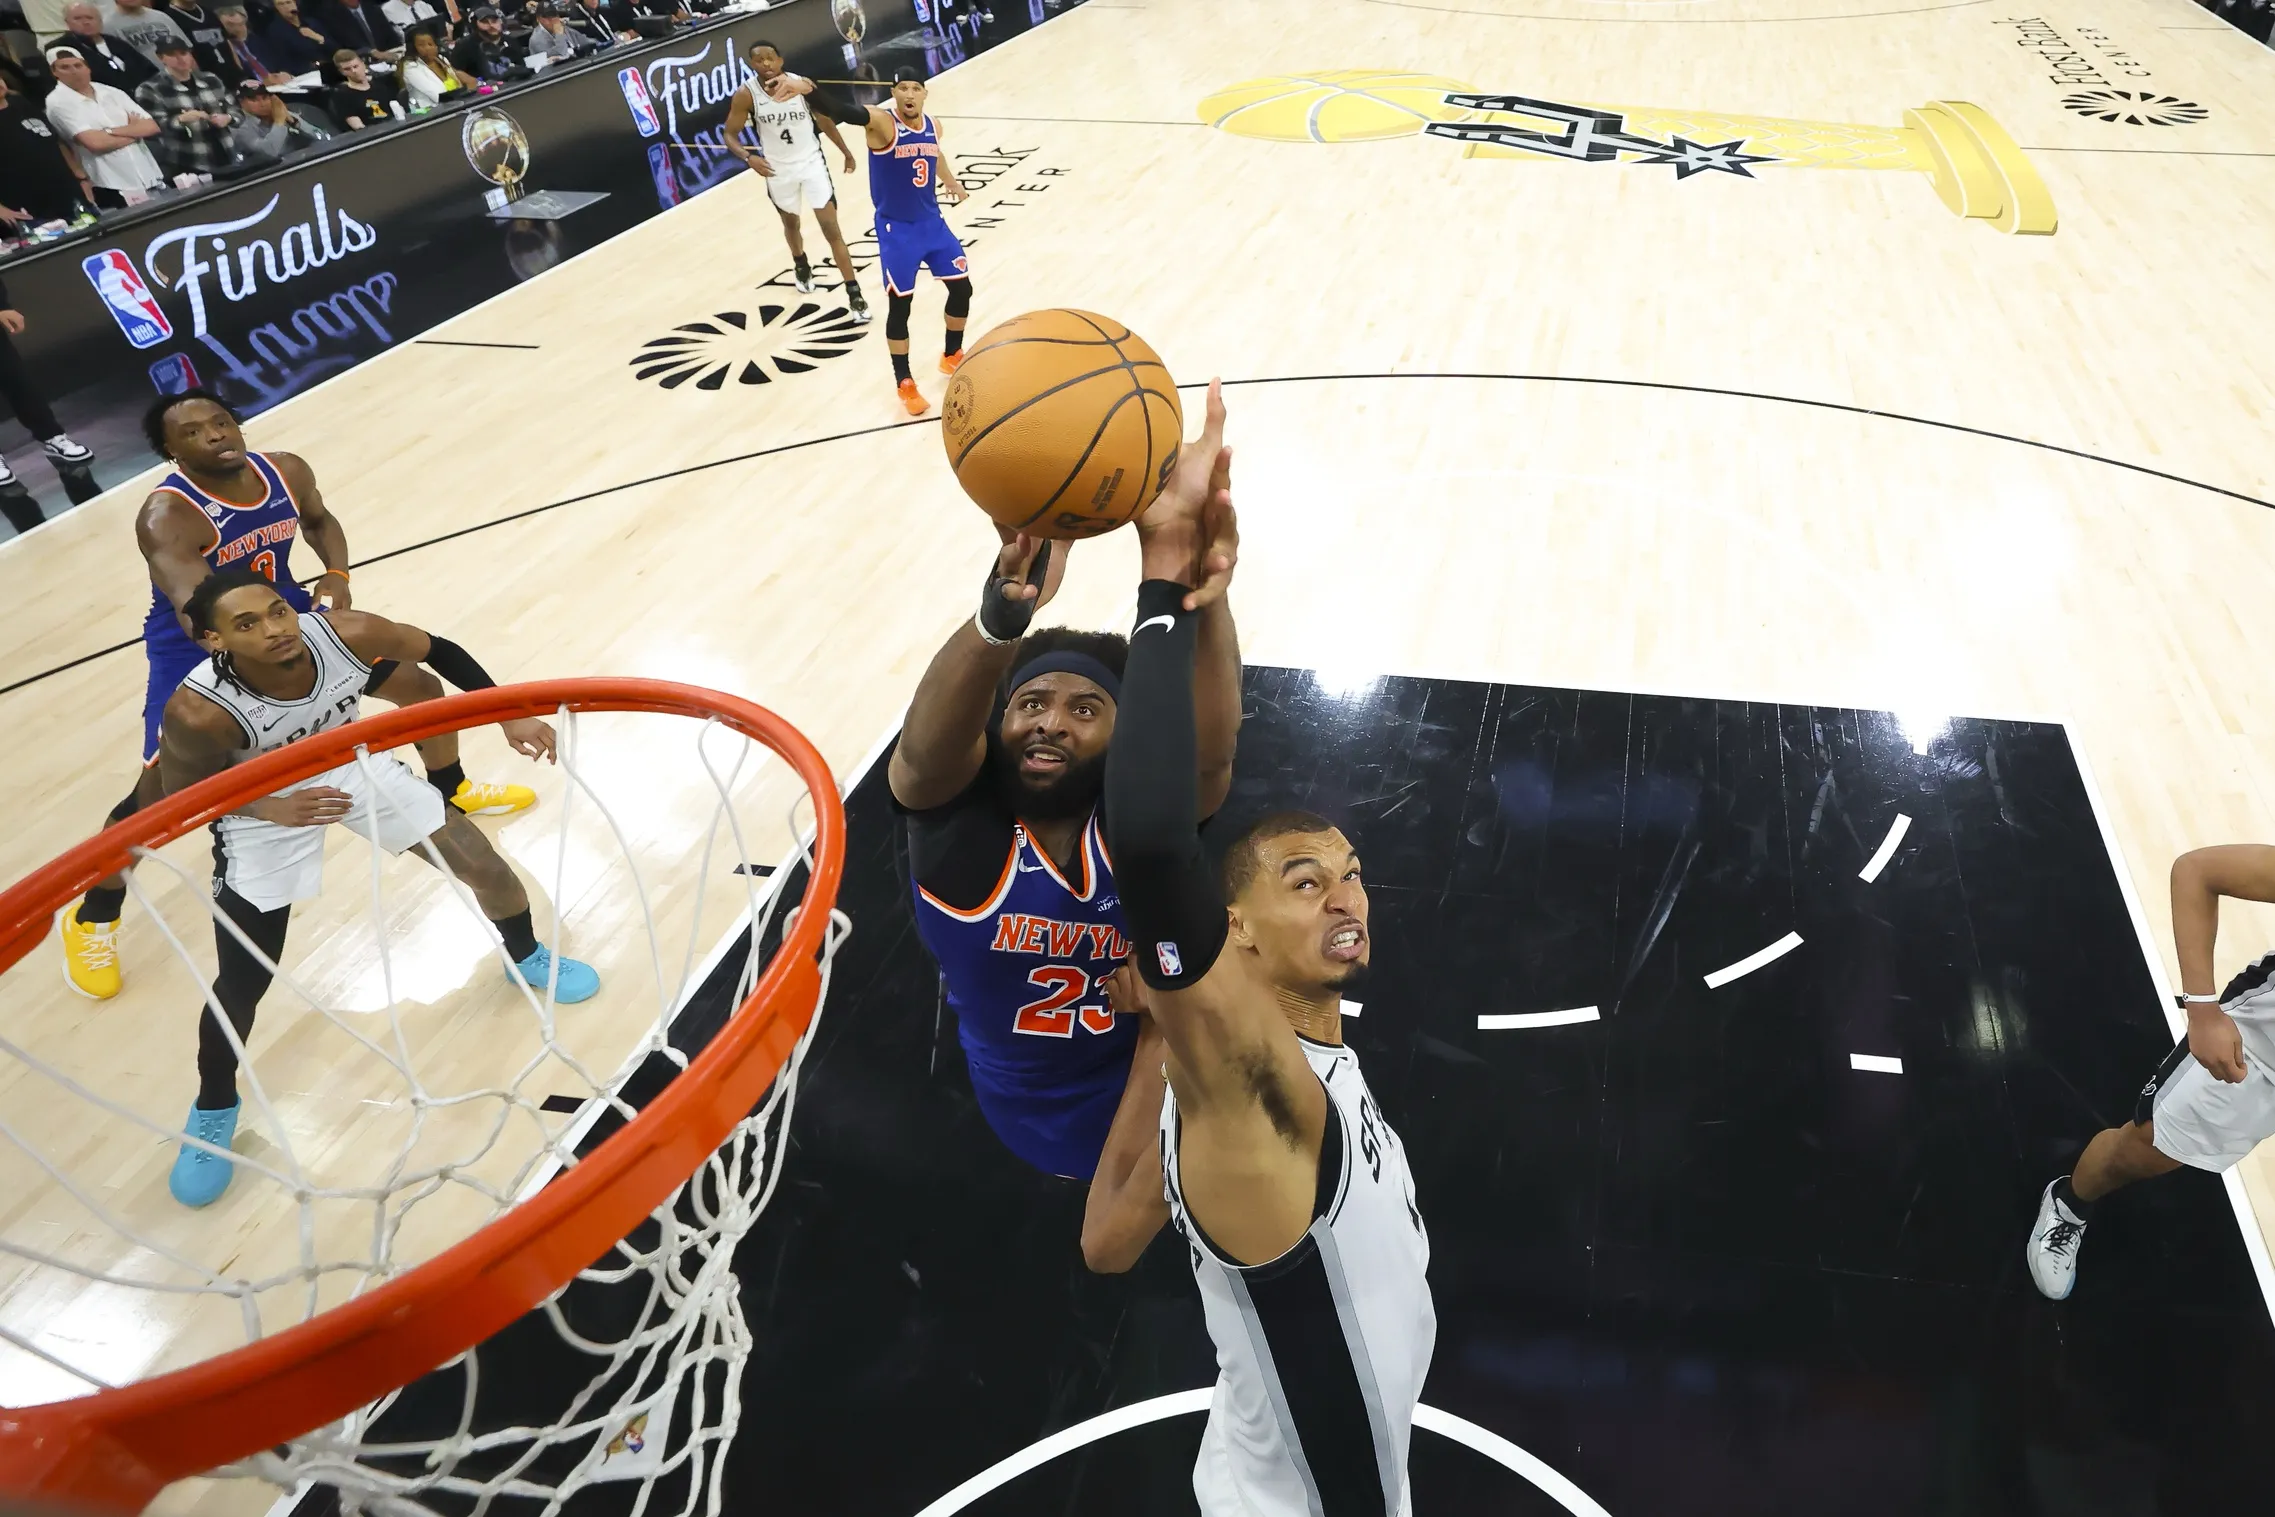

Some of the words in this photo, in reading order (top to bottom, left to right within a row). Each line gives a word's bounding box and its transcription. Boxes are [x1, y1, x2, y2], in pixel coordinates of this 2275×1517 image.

[2076, 28, 2151, 77] CENTER
[646, 36, 758, 135] Finals
[758, 111, 806, 126] SPURS
[781, 128, 793, 145] 4
[912, 158, 929, 188] 3
[145, 183, 376, 338] Finals
[131, 321, 157, 344] NBA
[216, 530, 258, 567] NEW
[990, 913, 1087, 958] NEW
